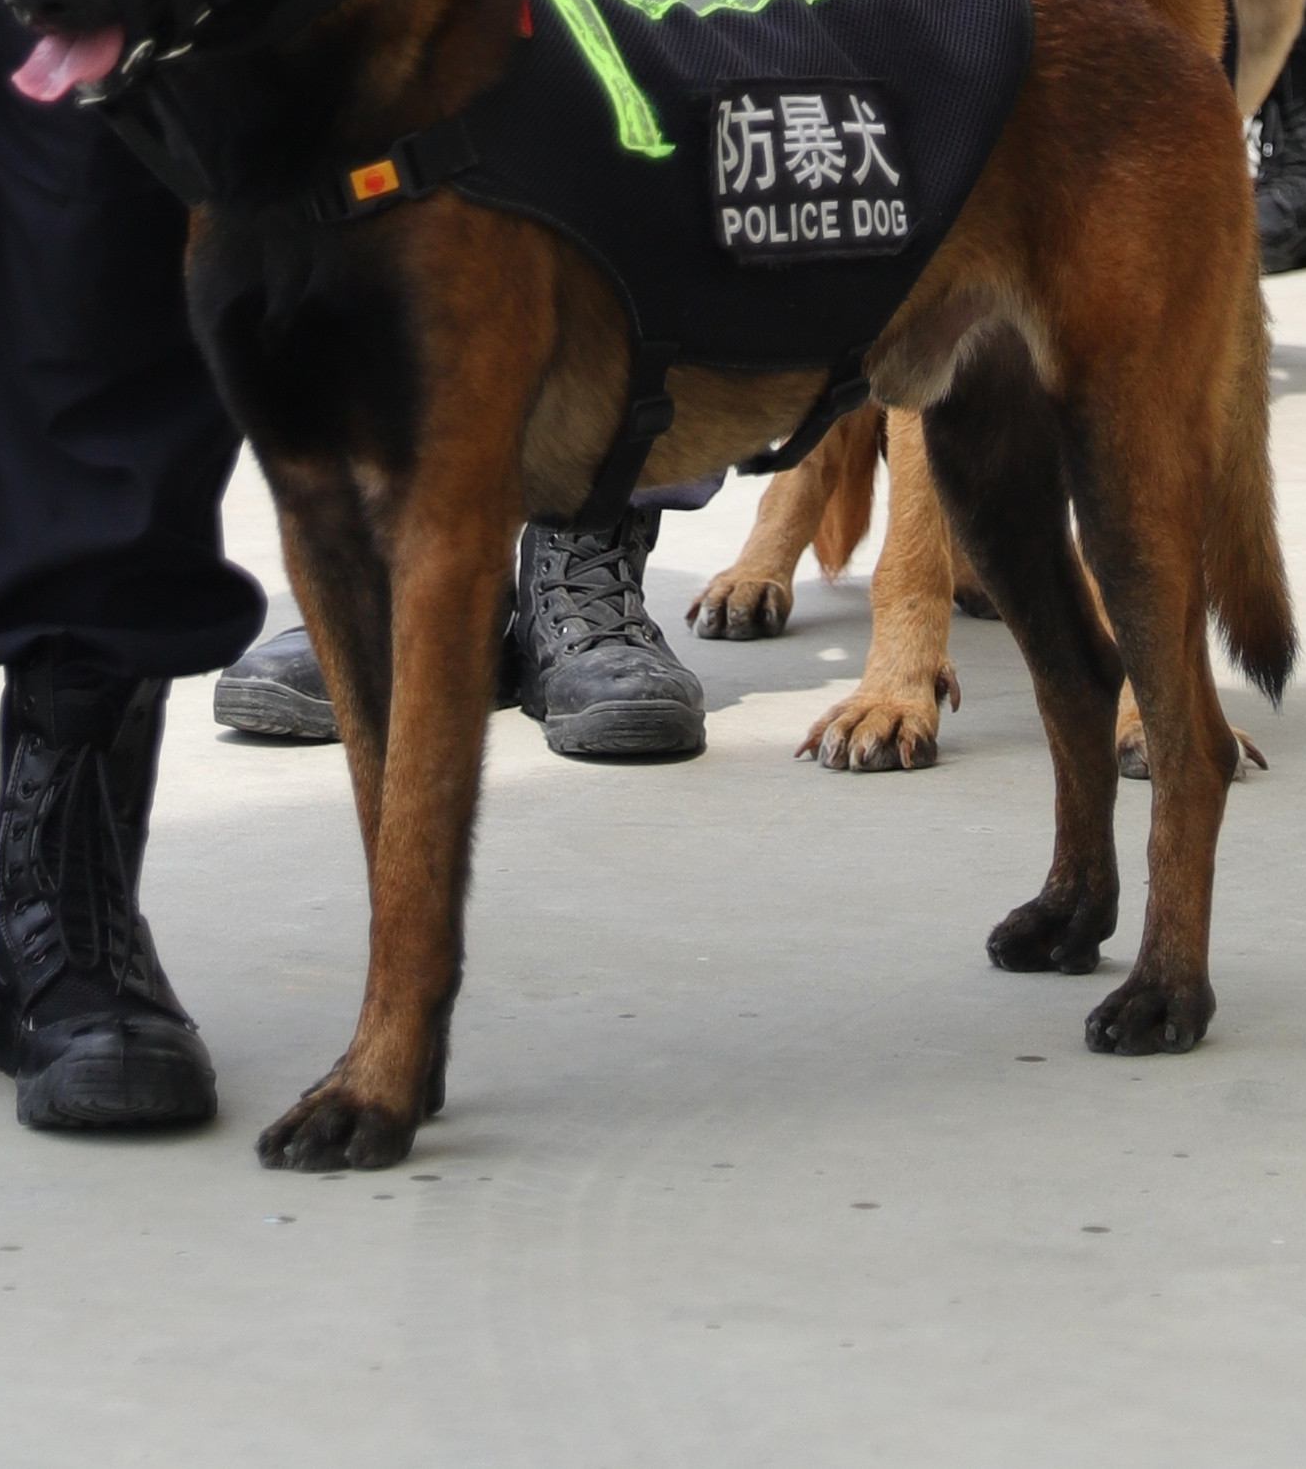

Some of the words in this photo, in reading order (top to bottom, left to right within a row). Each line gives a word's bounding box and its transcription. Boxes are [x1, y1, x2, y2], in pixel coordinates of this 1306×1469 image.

[717, 94, 900, 195] 防暴犬
[722, 200, 841, 246] POLICE
[852, 199, 908, 237] DOG
